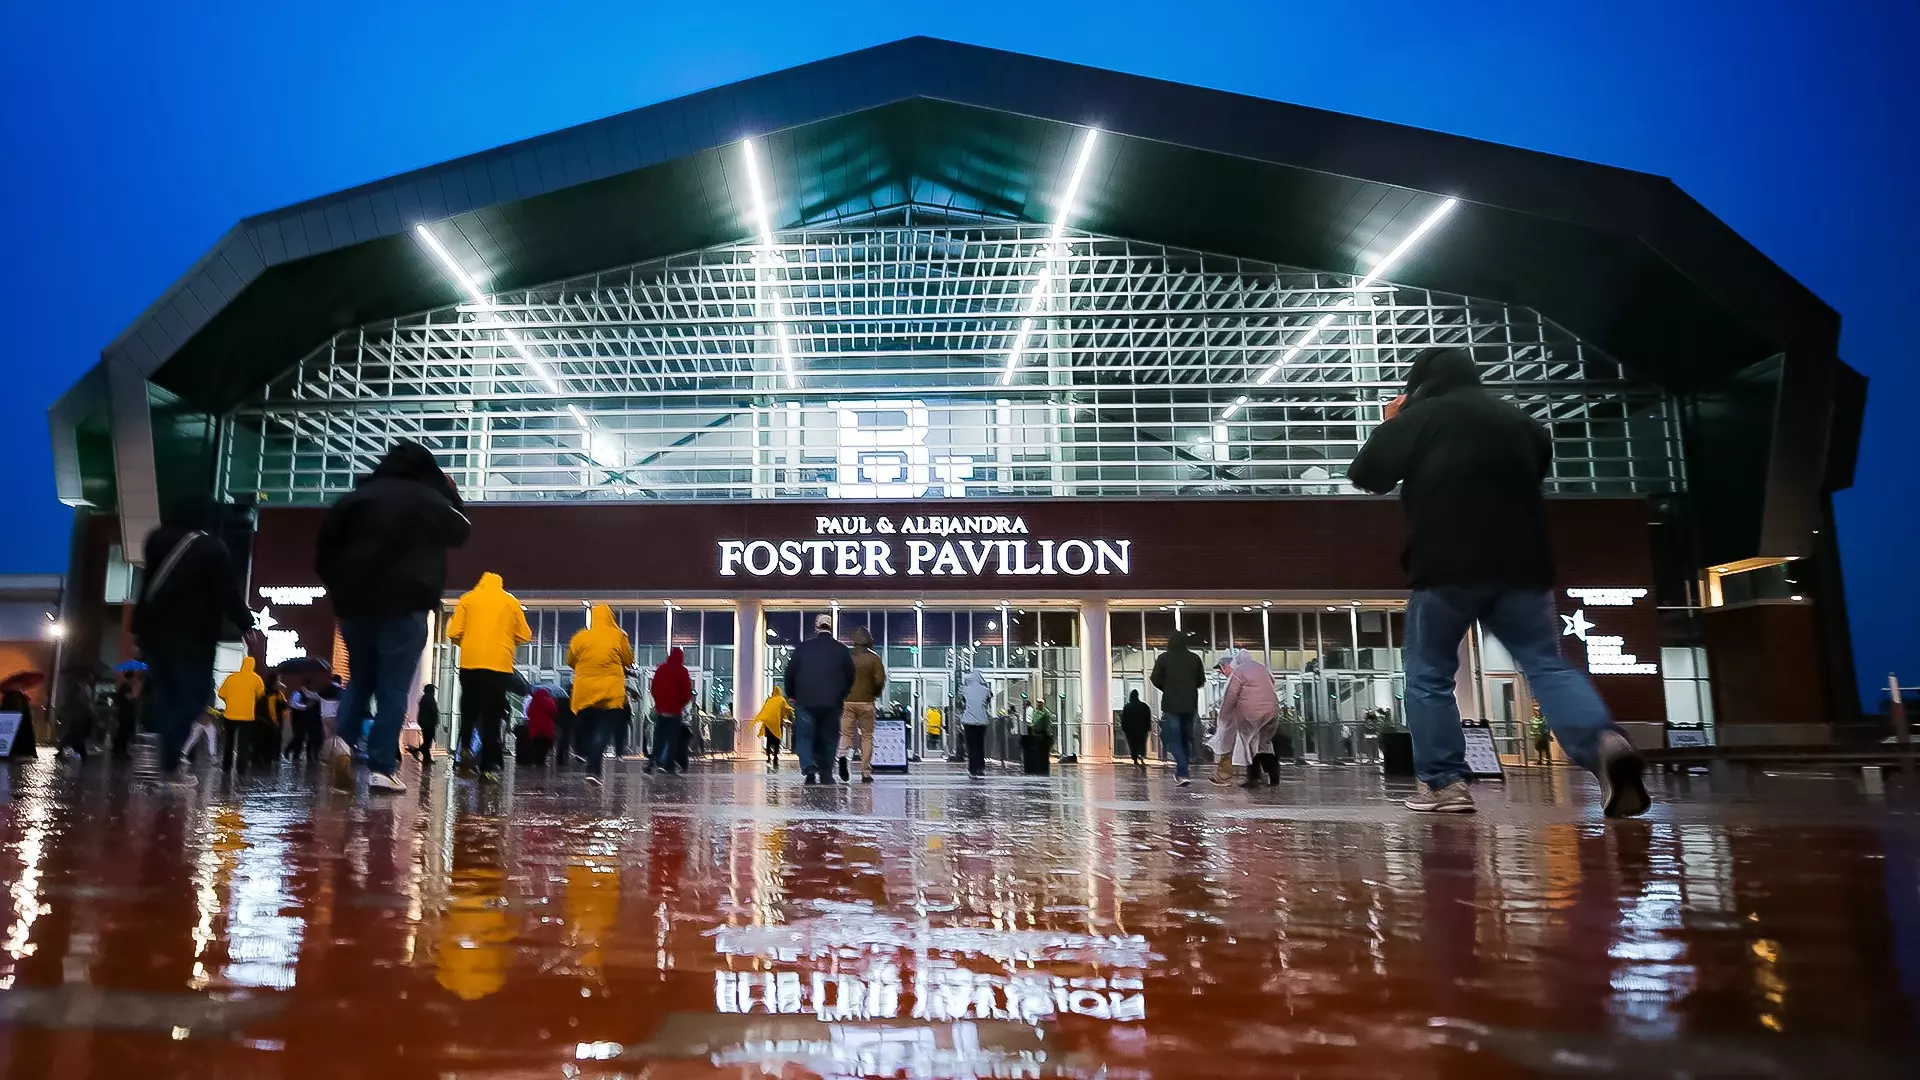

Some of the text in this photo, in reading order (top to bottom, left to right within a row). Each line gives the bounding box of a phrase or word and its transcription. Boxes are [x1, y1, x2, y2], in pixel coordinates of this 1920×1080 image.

[815, 516, 1029, 538] PAUL & ALEJANDRA
[717, 540, 1132, 576] FOSTER PAVILION
